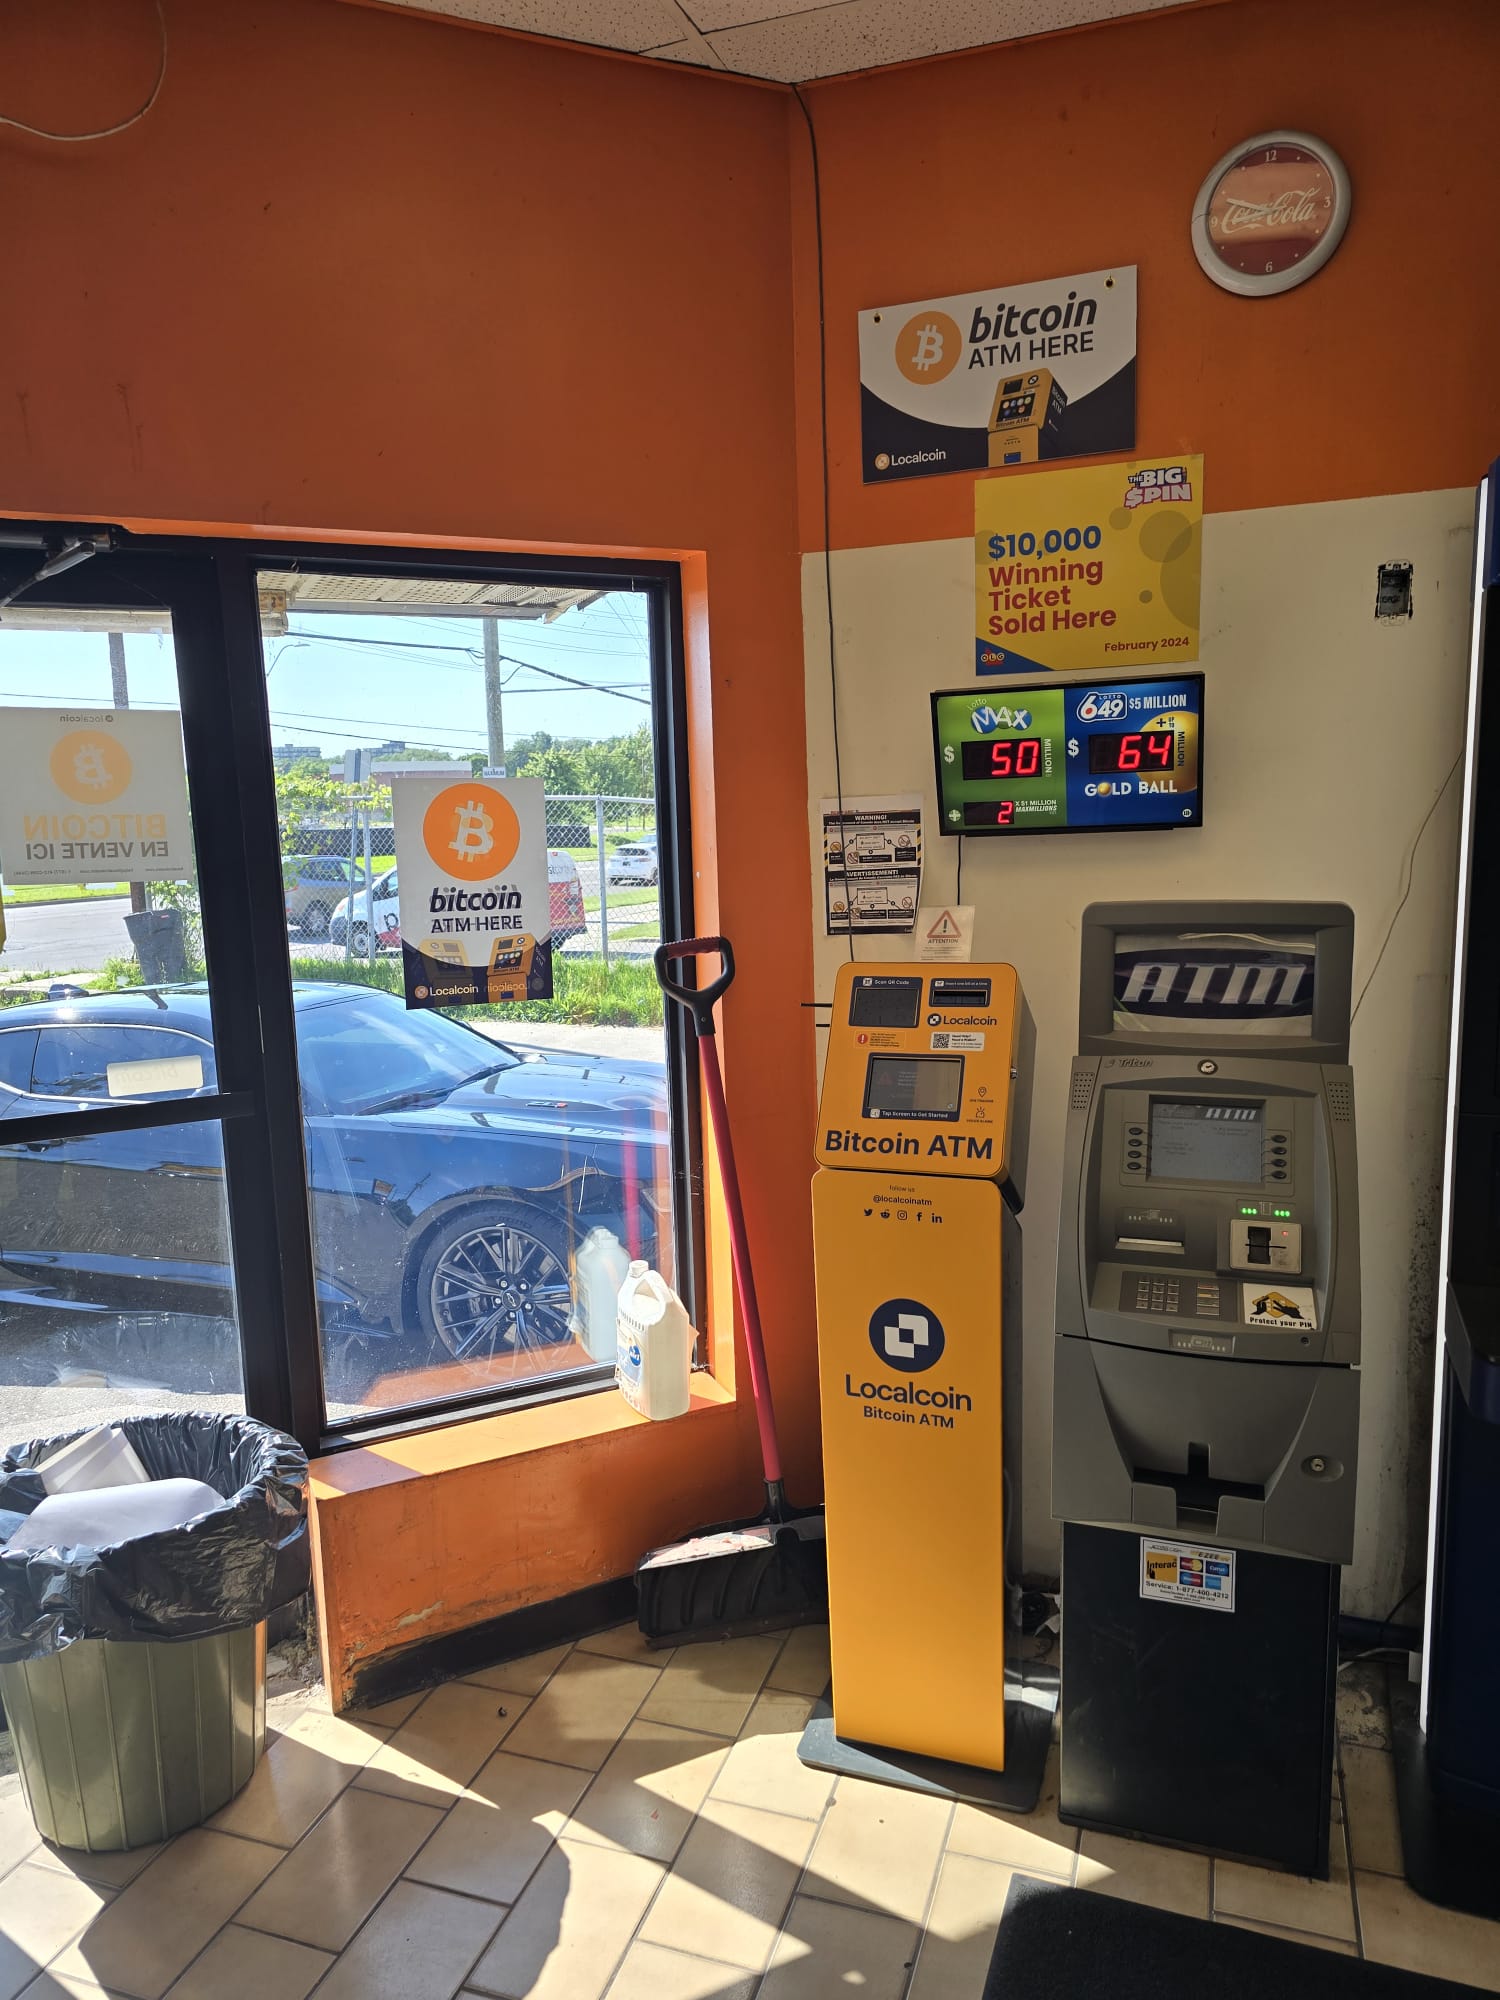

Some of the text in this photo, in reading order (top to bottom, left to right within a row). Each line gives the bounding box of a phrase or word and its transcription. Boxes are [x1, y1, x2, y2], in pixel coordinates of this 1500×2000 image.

[1265, 150, 1278, 162] 12
[1323, 196, 1332, 208] 3
[1210, 216, 1219, 228] 9
[1265, 261, 1274, 273] 6
[968, 291, 1098, 344] bitcoin
[968, 330, 1094, 370] ATM HERE
[891, 448, 946, 466] Localcoin
[1128, 466, 1182, 487] THE BIG
[988, 525, 1101, 561] $10,000
[988, 558, 1103, 587] Winning
[988, 585, 1071, 612] Ticket
[988, 609, 1117, 636] Sold Here
[1104, 636, 1190, 652] February 2024
[1129, 694, 1187, 709] $5 MILLION
[971, 706, 1028, 734] MAX
[943, 741, 1039, 775] $ 50
[1043, 738, 1053, 774] MILLION
[1067, 734, 1172, 769] $ 64
[1177, 731, 1185, 766] MILLION
[1139, 780, 1178, 794] BALL
[997, 801, 1013, 824] 2
[429, 884, 522, 913] bitcoin
[431, 915, 523, 933] ATM HERE
[429, 983, 479, 997] Localcoin
[1120, 962, 1307, 1006] ATM
[943, 1015, 998, 1026] Localcoin
[1118, 1058, 1153, 1069] Triton
[882, 1110, 892, 1118] Tap
[1205, 1108, 1257, 1120] ATM
[825, 1129, 993, 1160] Bitcoin ATM
[873, 1194, 932, 1206] @localcoinatm
[1249, 1316, 1278, 1325] Protect
[845, 1374, 972, 1412] Localcoin
[863, 1405, 954, 1429] Bitcoin ATM
[1146, 1560, 1177, 1569] Interac
[1145, 1581, 1174, 1591] Service:
